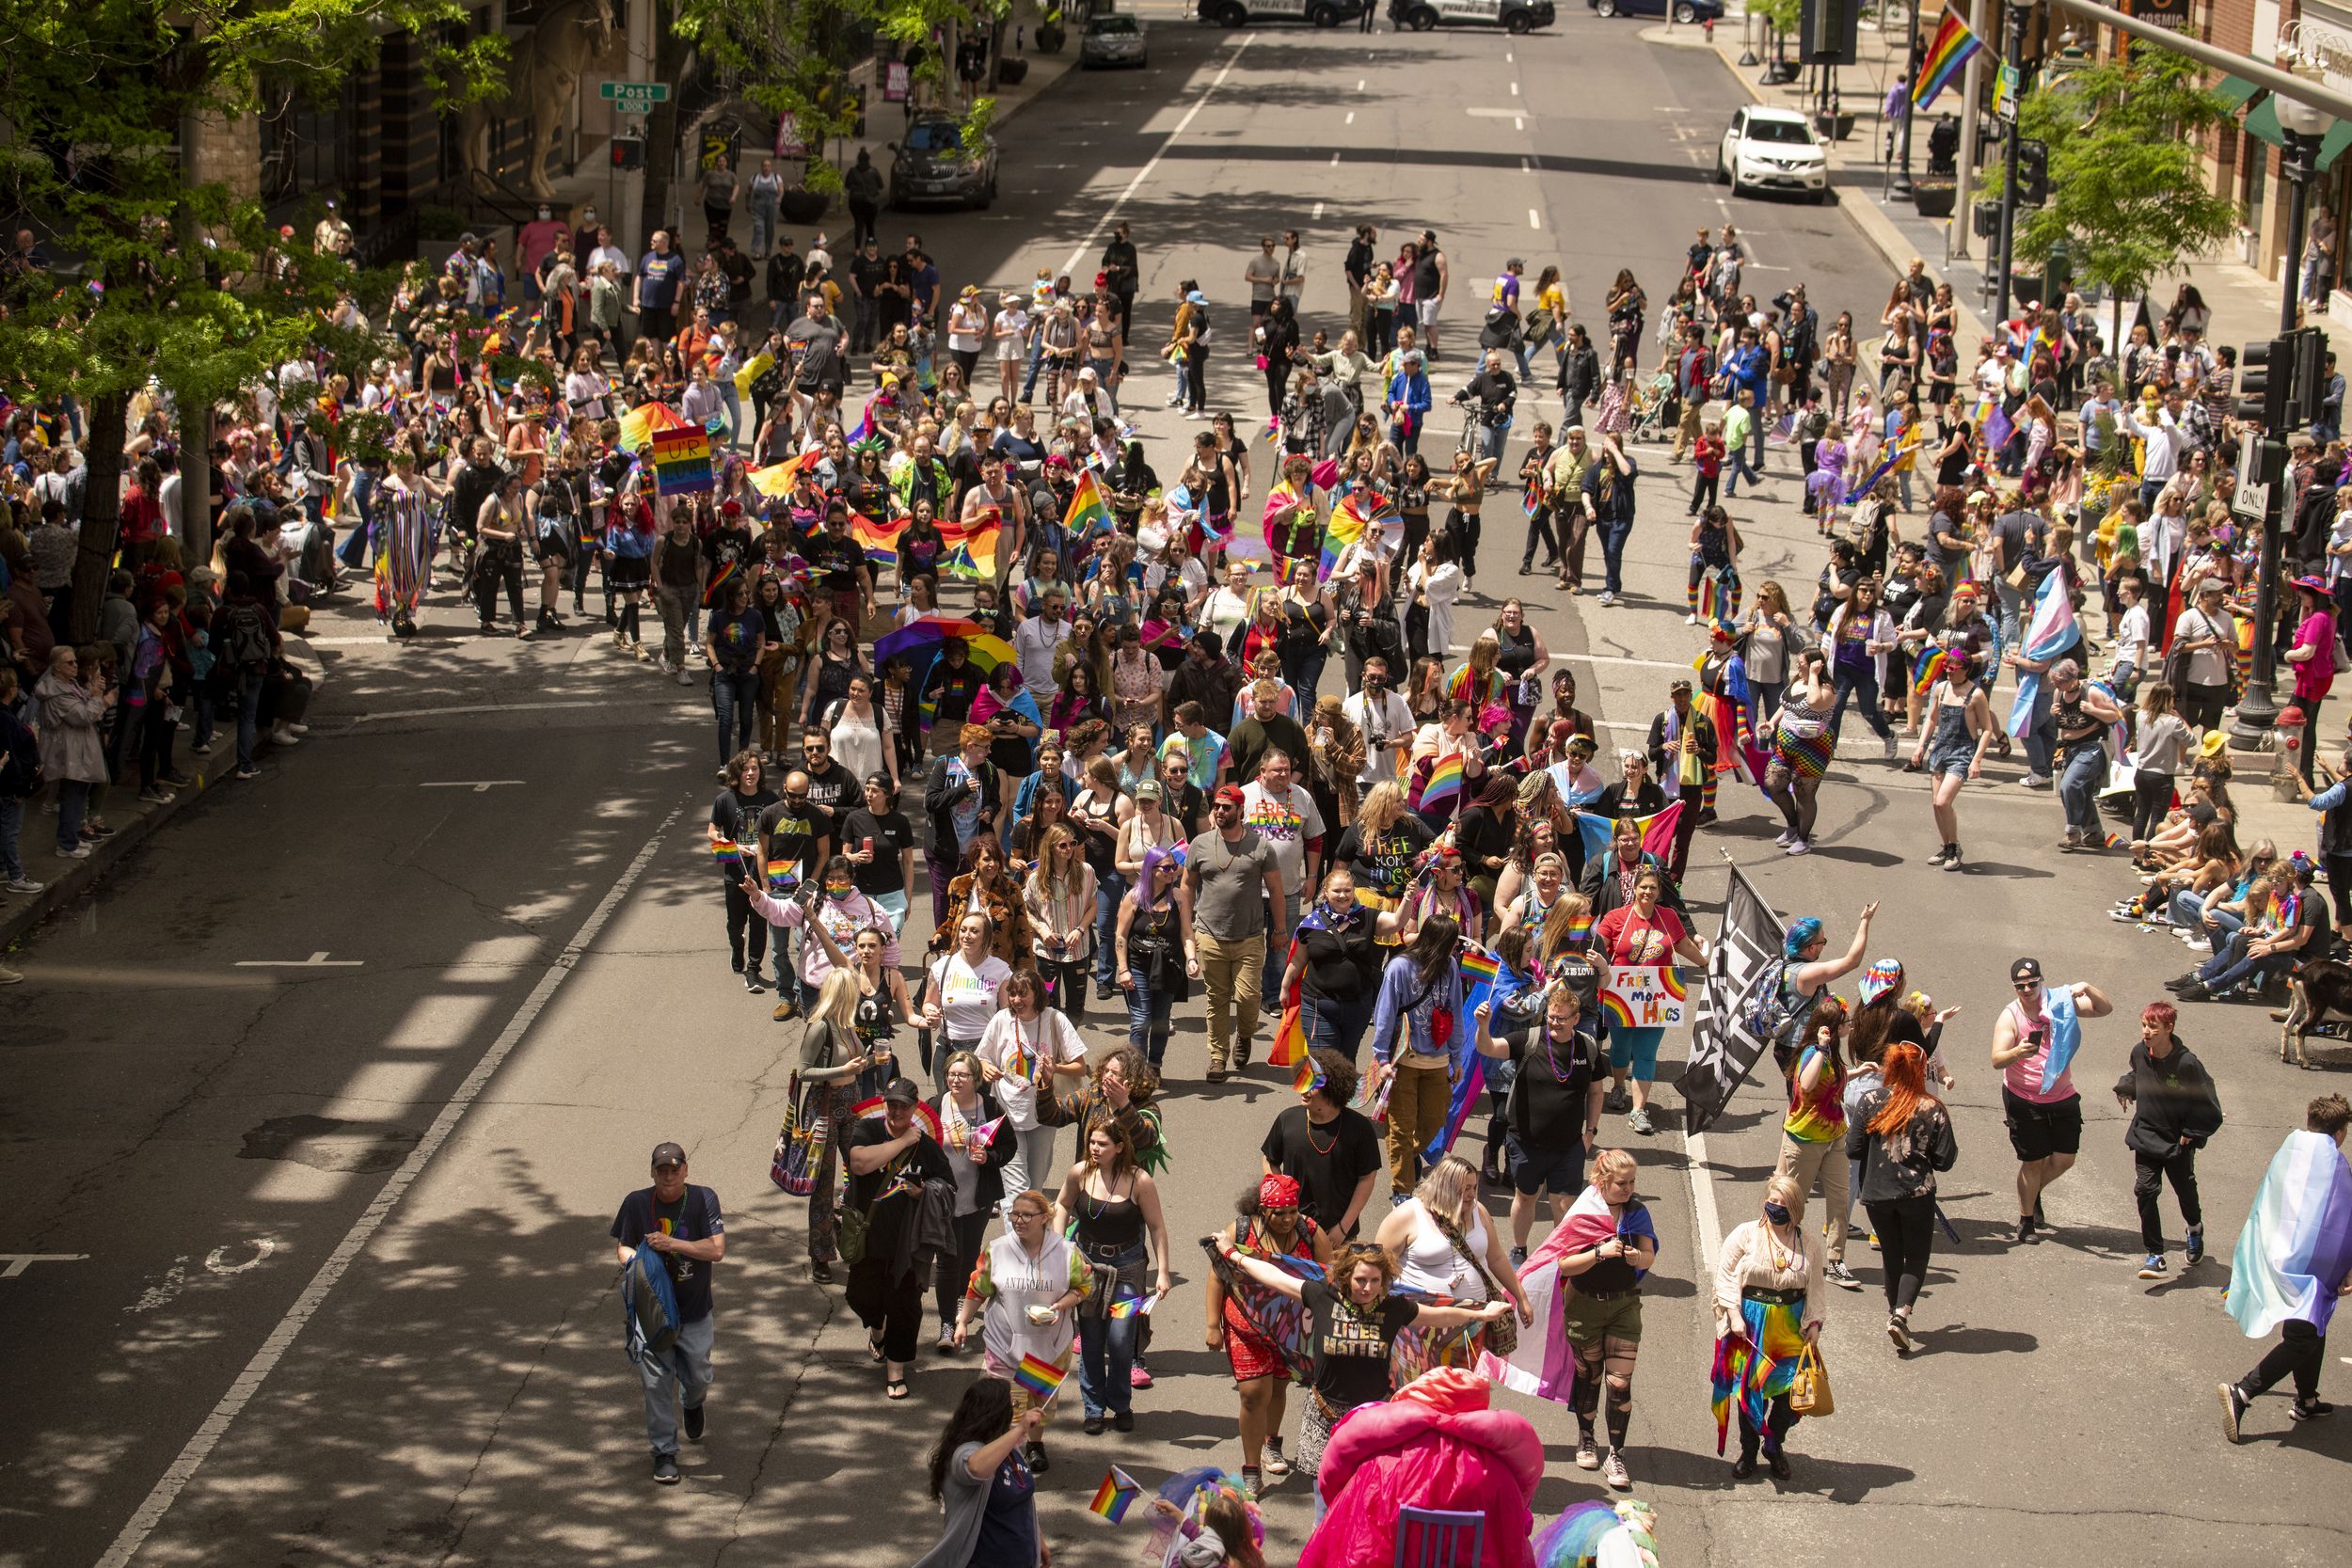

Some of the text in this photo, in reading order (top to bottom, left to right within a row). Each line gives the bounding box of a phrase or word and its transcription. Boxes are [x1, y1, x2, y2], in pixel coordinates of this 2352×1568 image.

[2137, 12, 2185, 27] COSMIC
[614, 85, 653, 99] Post
[623, 101, 644, 111] 100N
[668, 439, 700, 460] U'R
[2242, 490, 2265, 511] ONLY
[1255, 802, 1295, 814] FREE
[1366, 835, 1411, 856] FREE
[1375, 855, 1406, 866] MOM
[1370, 866, 1412, 884] HUGS
[1578, 967, 1596, 975] LOVE
[1004, 1276, 1055, 1291] ANTISOCIAL
[1332, 1321, 1380, 1340] LIVES
[1323, 1336, 1389, 1358] MATTER
